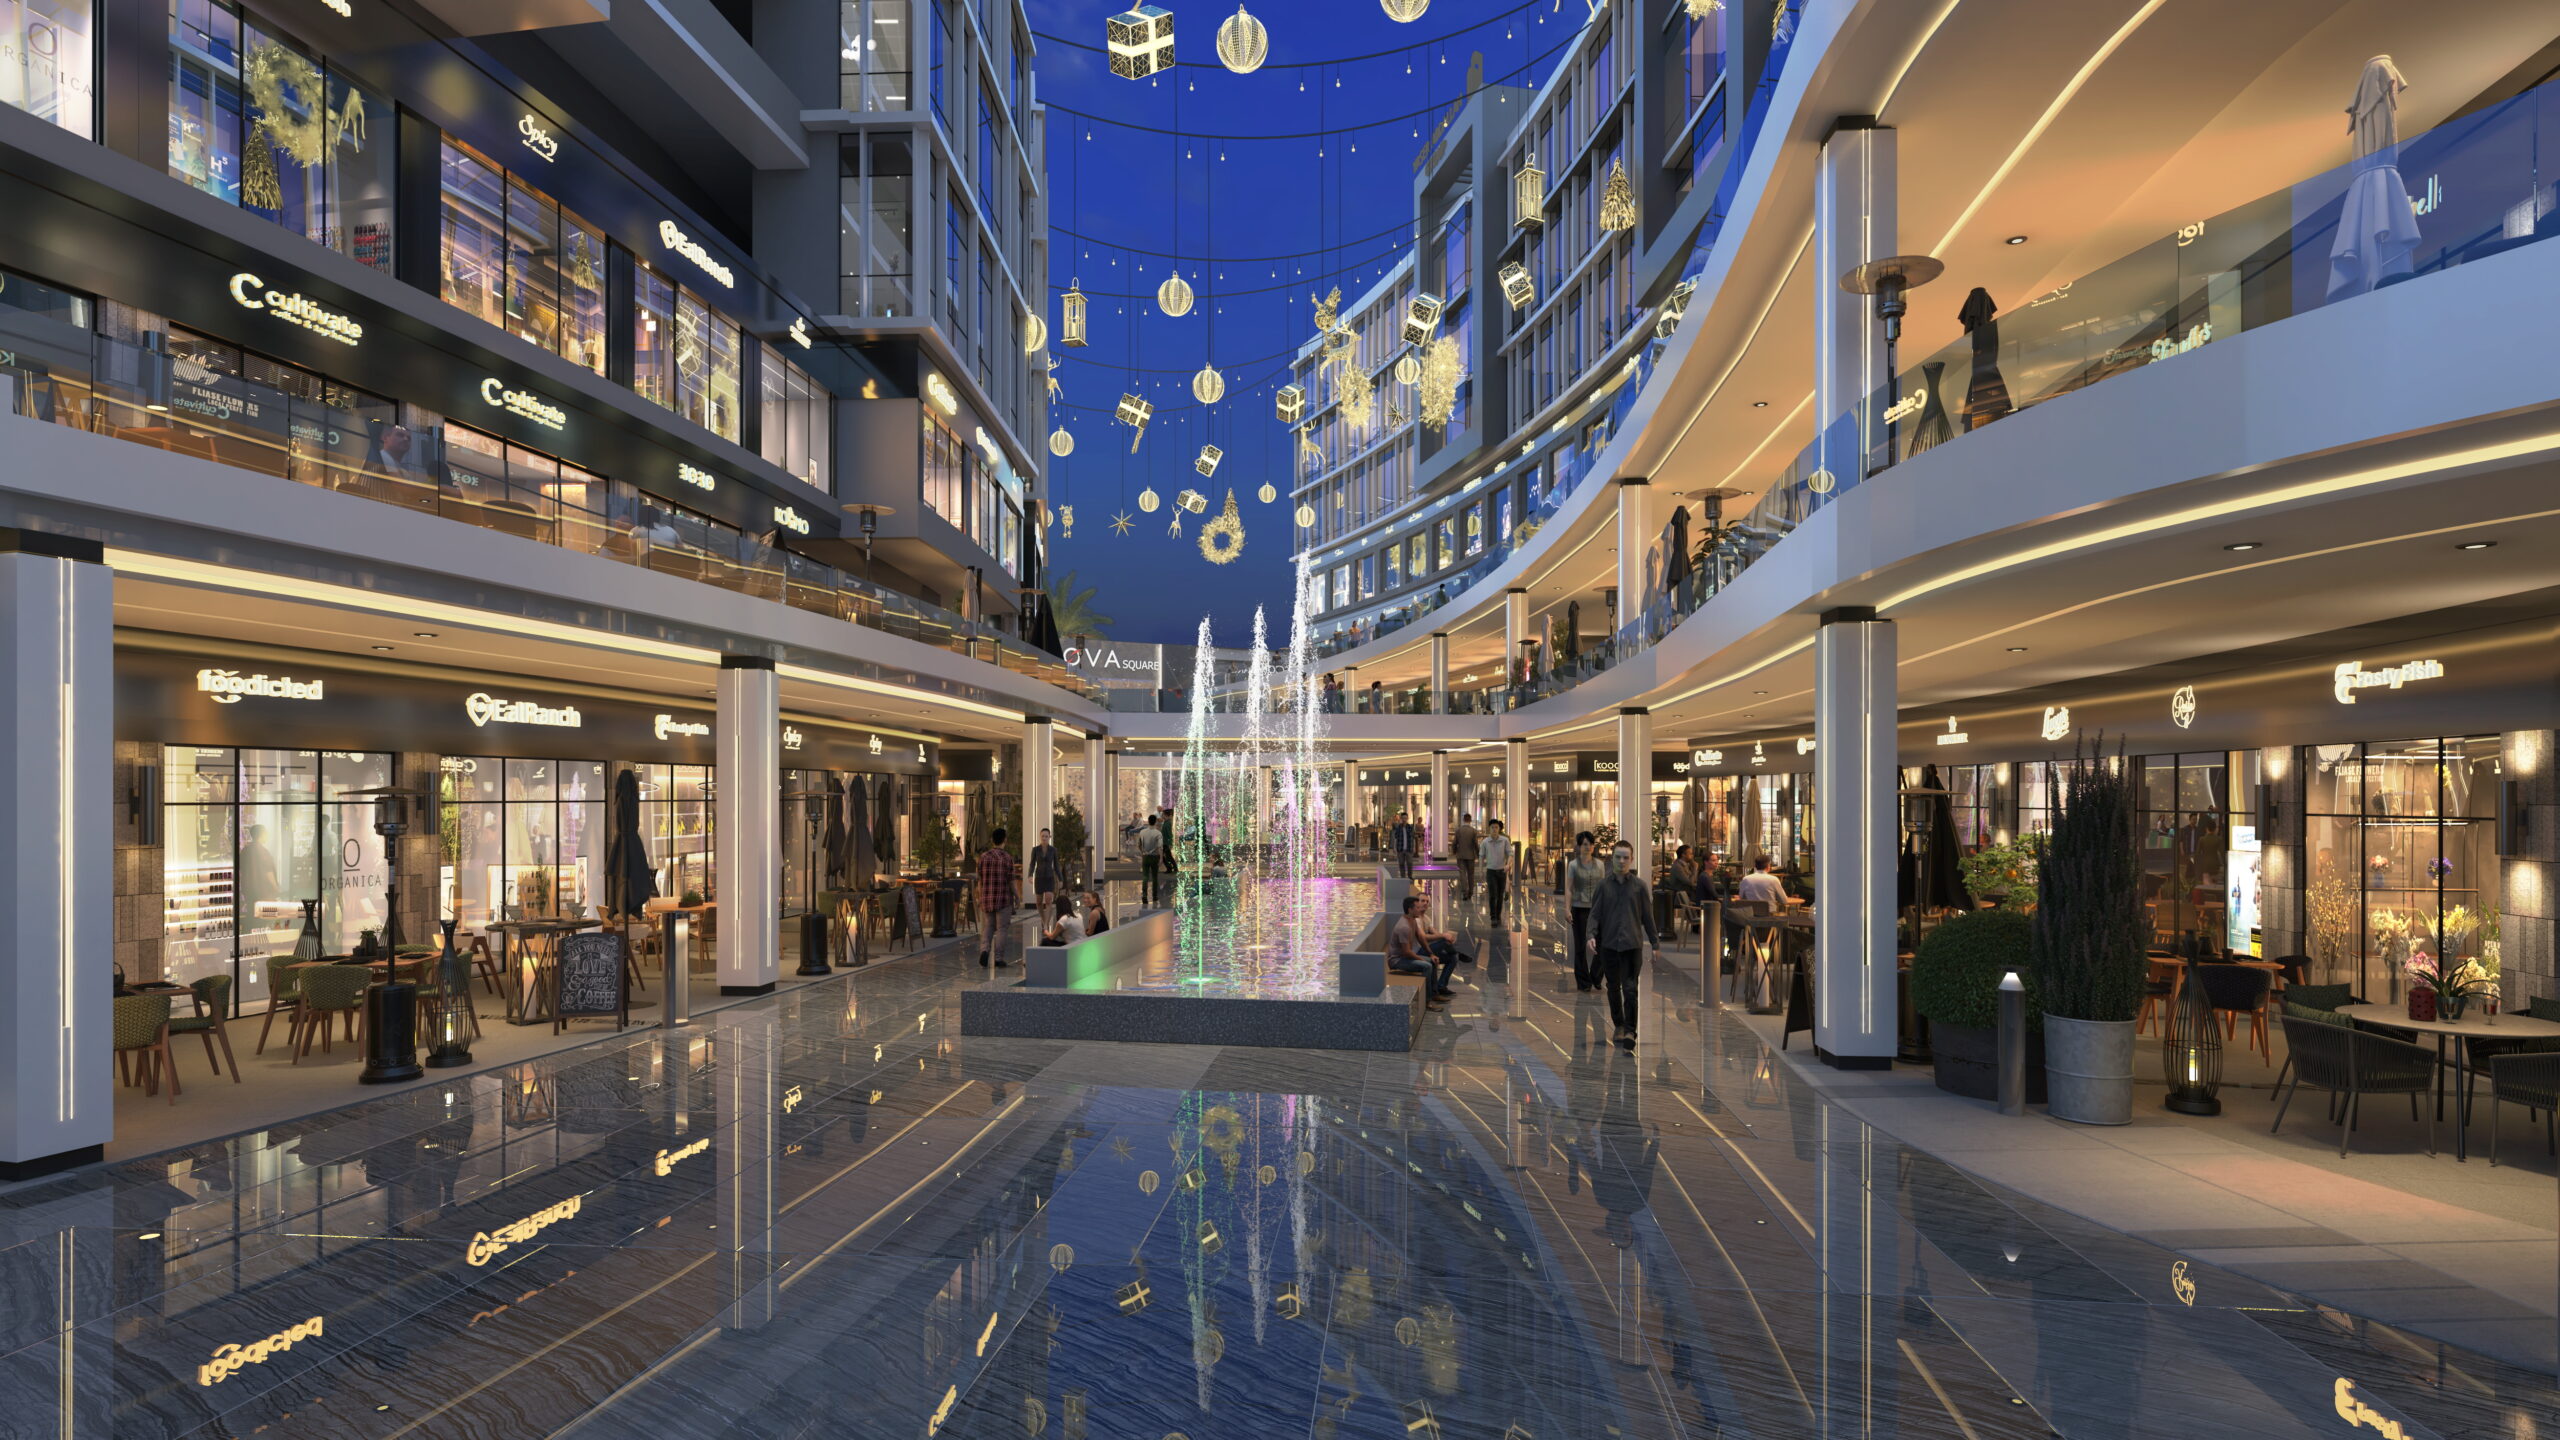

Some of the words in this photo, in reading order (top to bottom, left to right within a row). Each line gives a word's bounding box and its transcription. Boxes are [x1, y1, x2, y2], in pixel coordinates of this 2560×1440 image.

[1122, 659, 1160, 673] SQUARE
[196, 668, 323, 702] foodicted
[321, 874, 382, 891] ORGANICA
[574, 959, 608, 975] LOVE
[577, 988, 617, 1005] COFFEE
